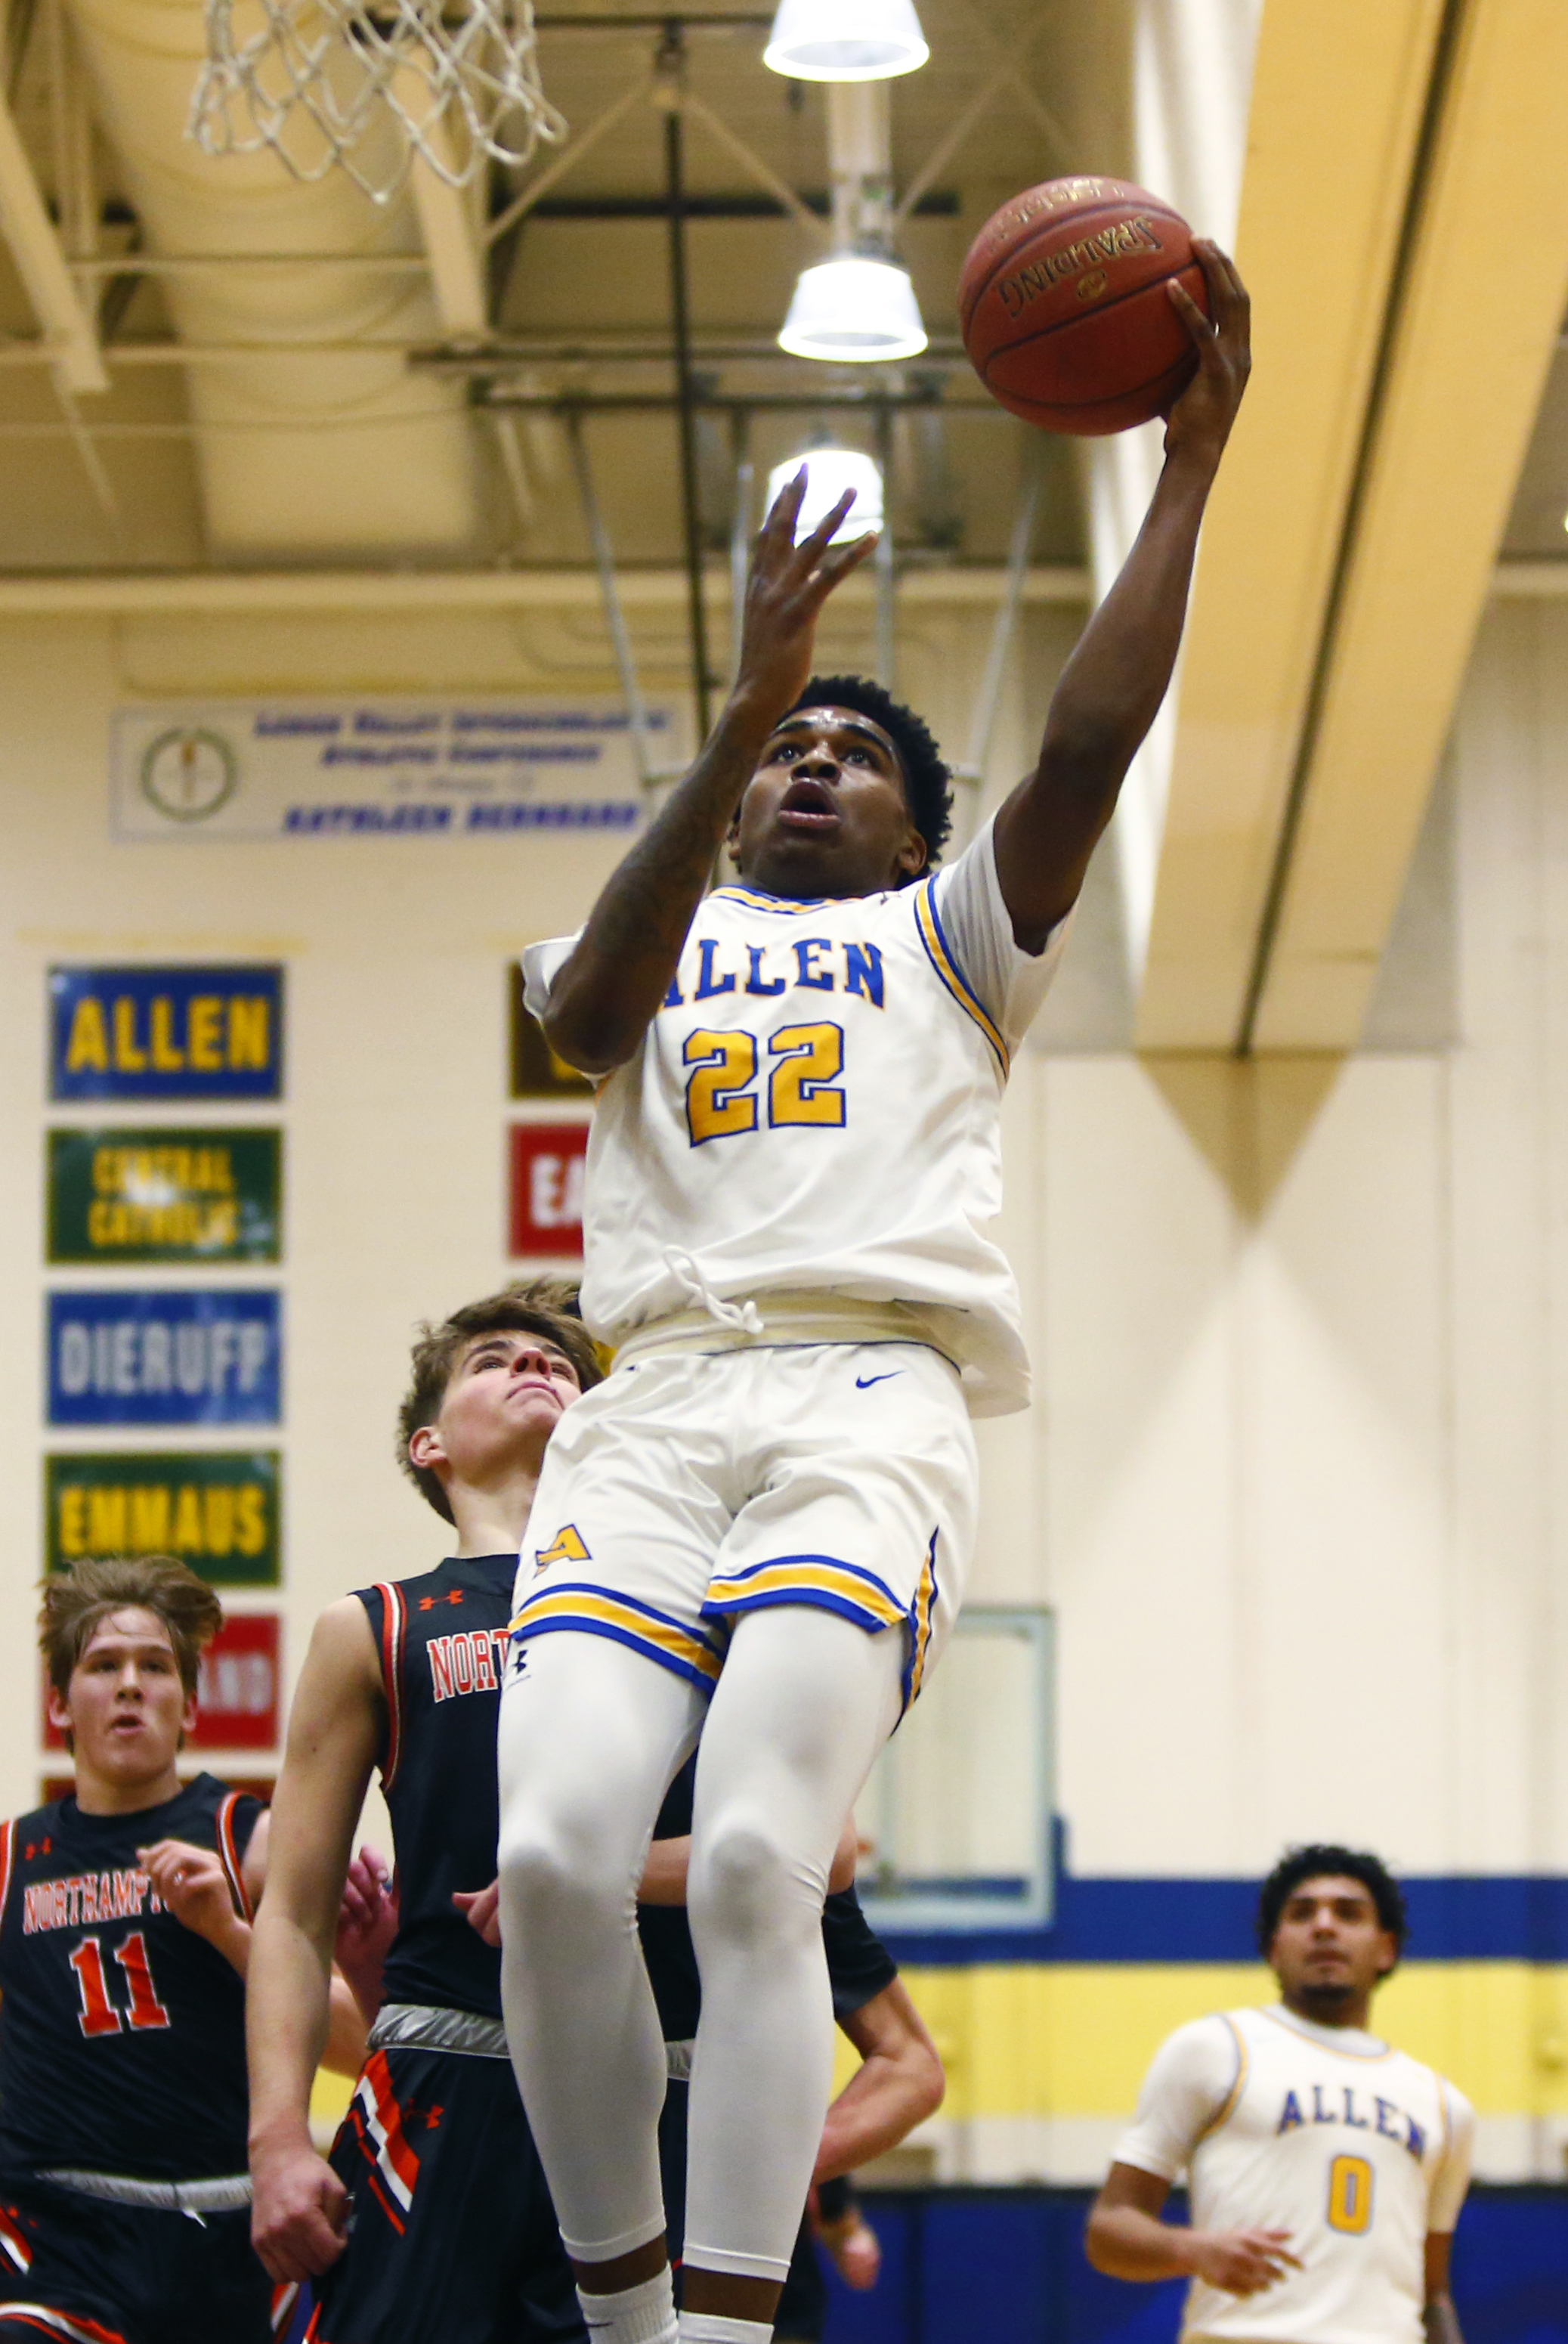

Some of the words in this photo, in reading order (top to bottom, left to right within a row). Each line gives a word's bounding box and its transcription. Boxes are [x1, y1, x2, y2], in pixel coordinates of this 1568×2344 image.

[997, 215, 1162, 317] SPALDING
[66, 994, 271, 1073] ALLEN
[682, 1020, 846, 1148] 22
[60, 1482, 268, 1557] EMMAUS
[425, 1628, 509, 1704] NORT
[23, 1868, 174, 1936] NORTHAMP
[68, 1931, 171, 2039] 11
[1276, 2084, 1427, 2164] ALLEN
[1327, 2154, 1373, 2237] 0
